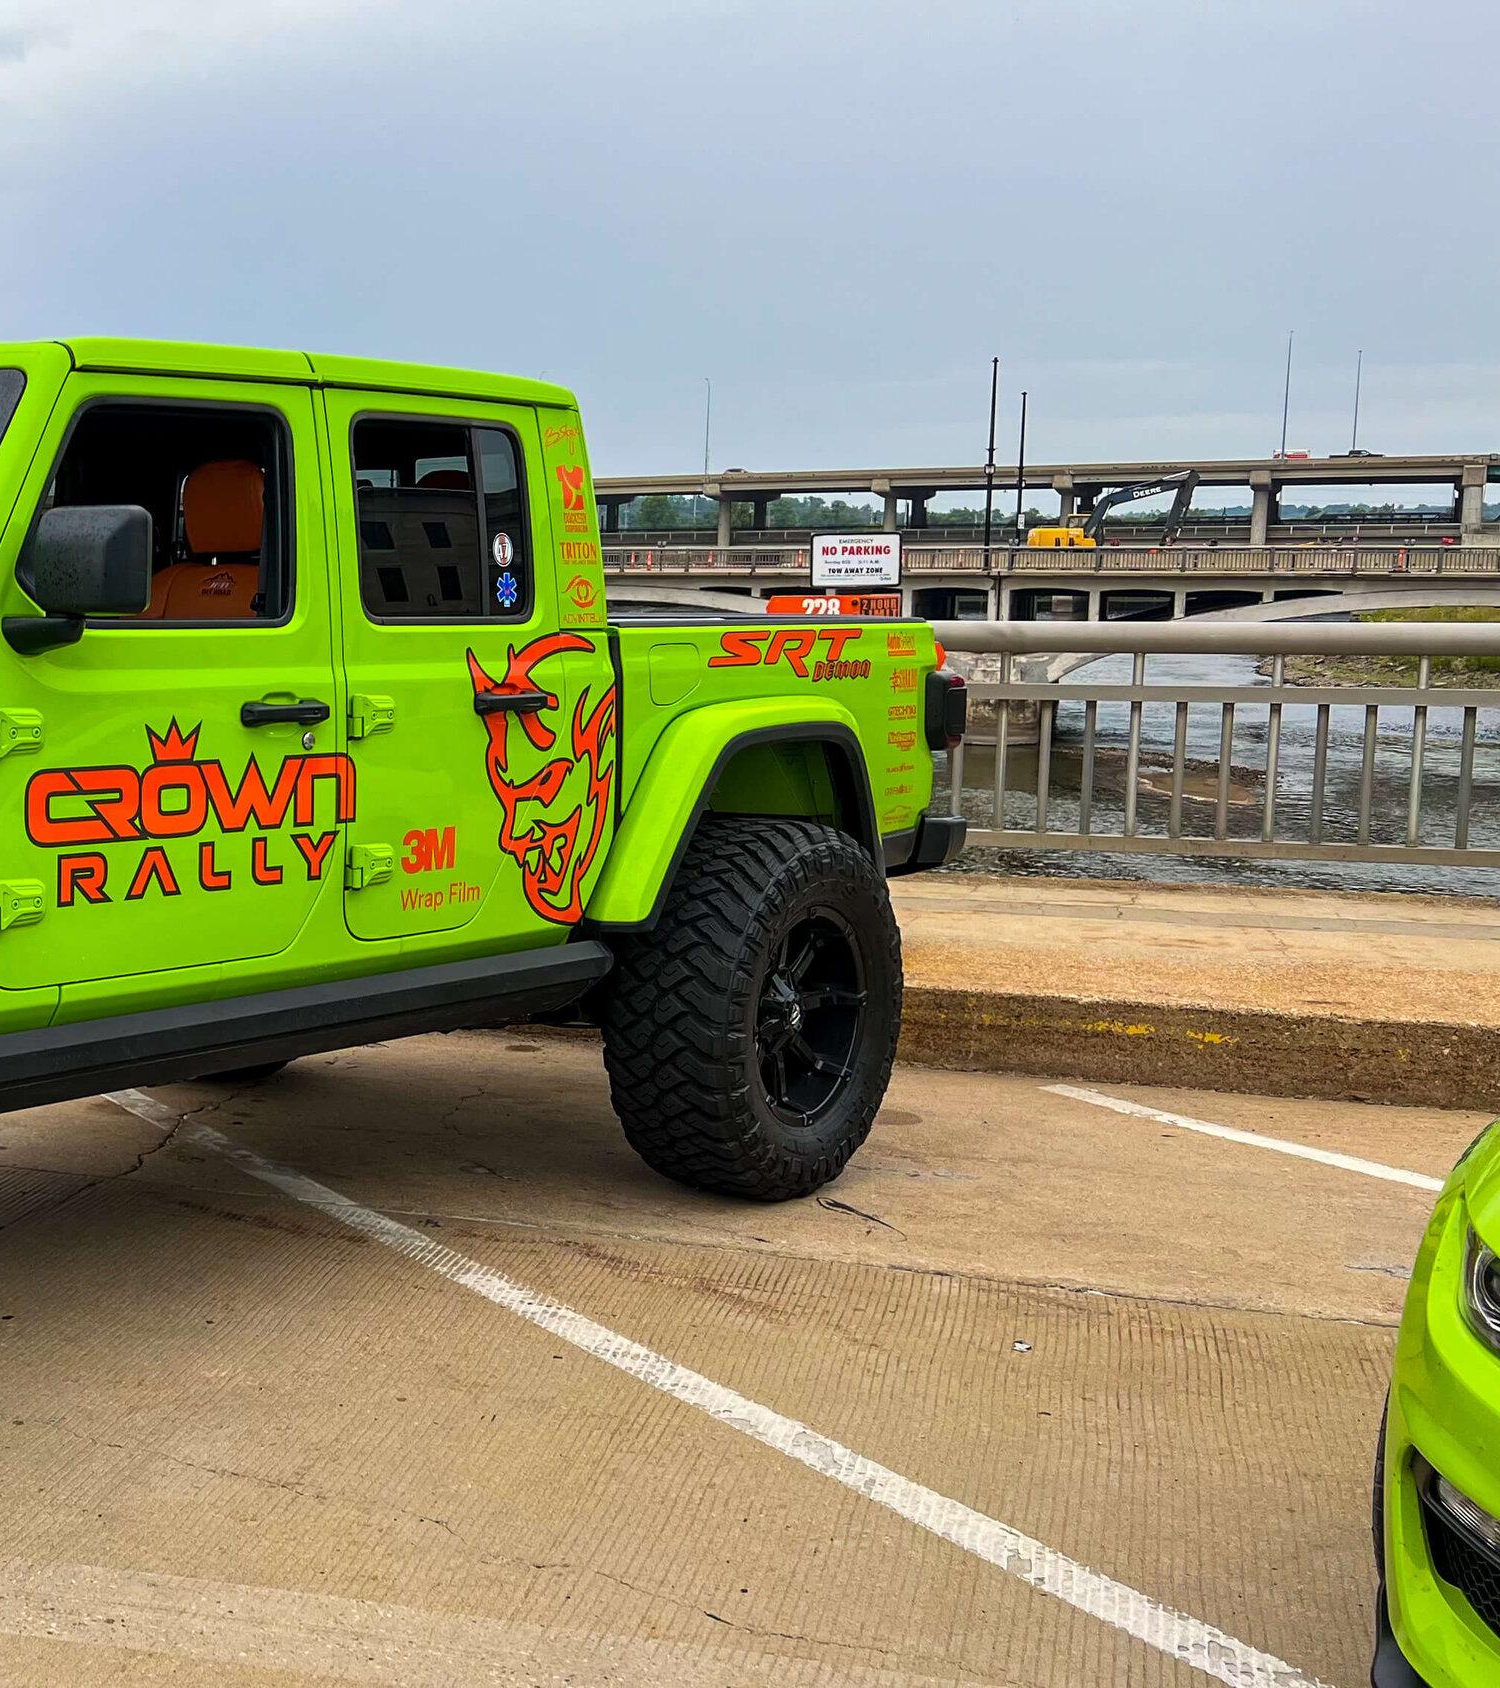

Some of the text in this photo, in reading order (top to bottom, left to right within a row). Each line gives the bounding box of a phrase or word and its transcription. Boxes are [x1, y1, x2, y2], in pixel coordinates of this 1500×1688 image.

[1133, 487, 1162, 498] DEERE
[560, 542, 597, 560] TRITON
[822, 546, 891, 556] NO PARKING
[802, 598, 840, 615] 228
[862, 599, 896, 610] 2 HOUR
[708, 628, 863, 677] SRT
[812, 659, 872, 682] DEMON
[24, 751, 357, 848] CROWN
[400, 826, 456, 875] 3M
[56, 830, 340, 908] RALLY
[400, 881, 481, 912] Wrap Film
